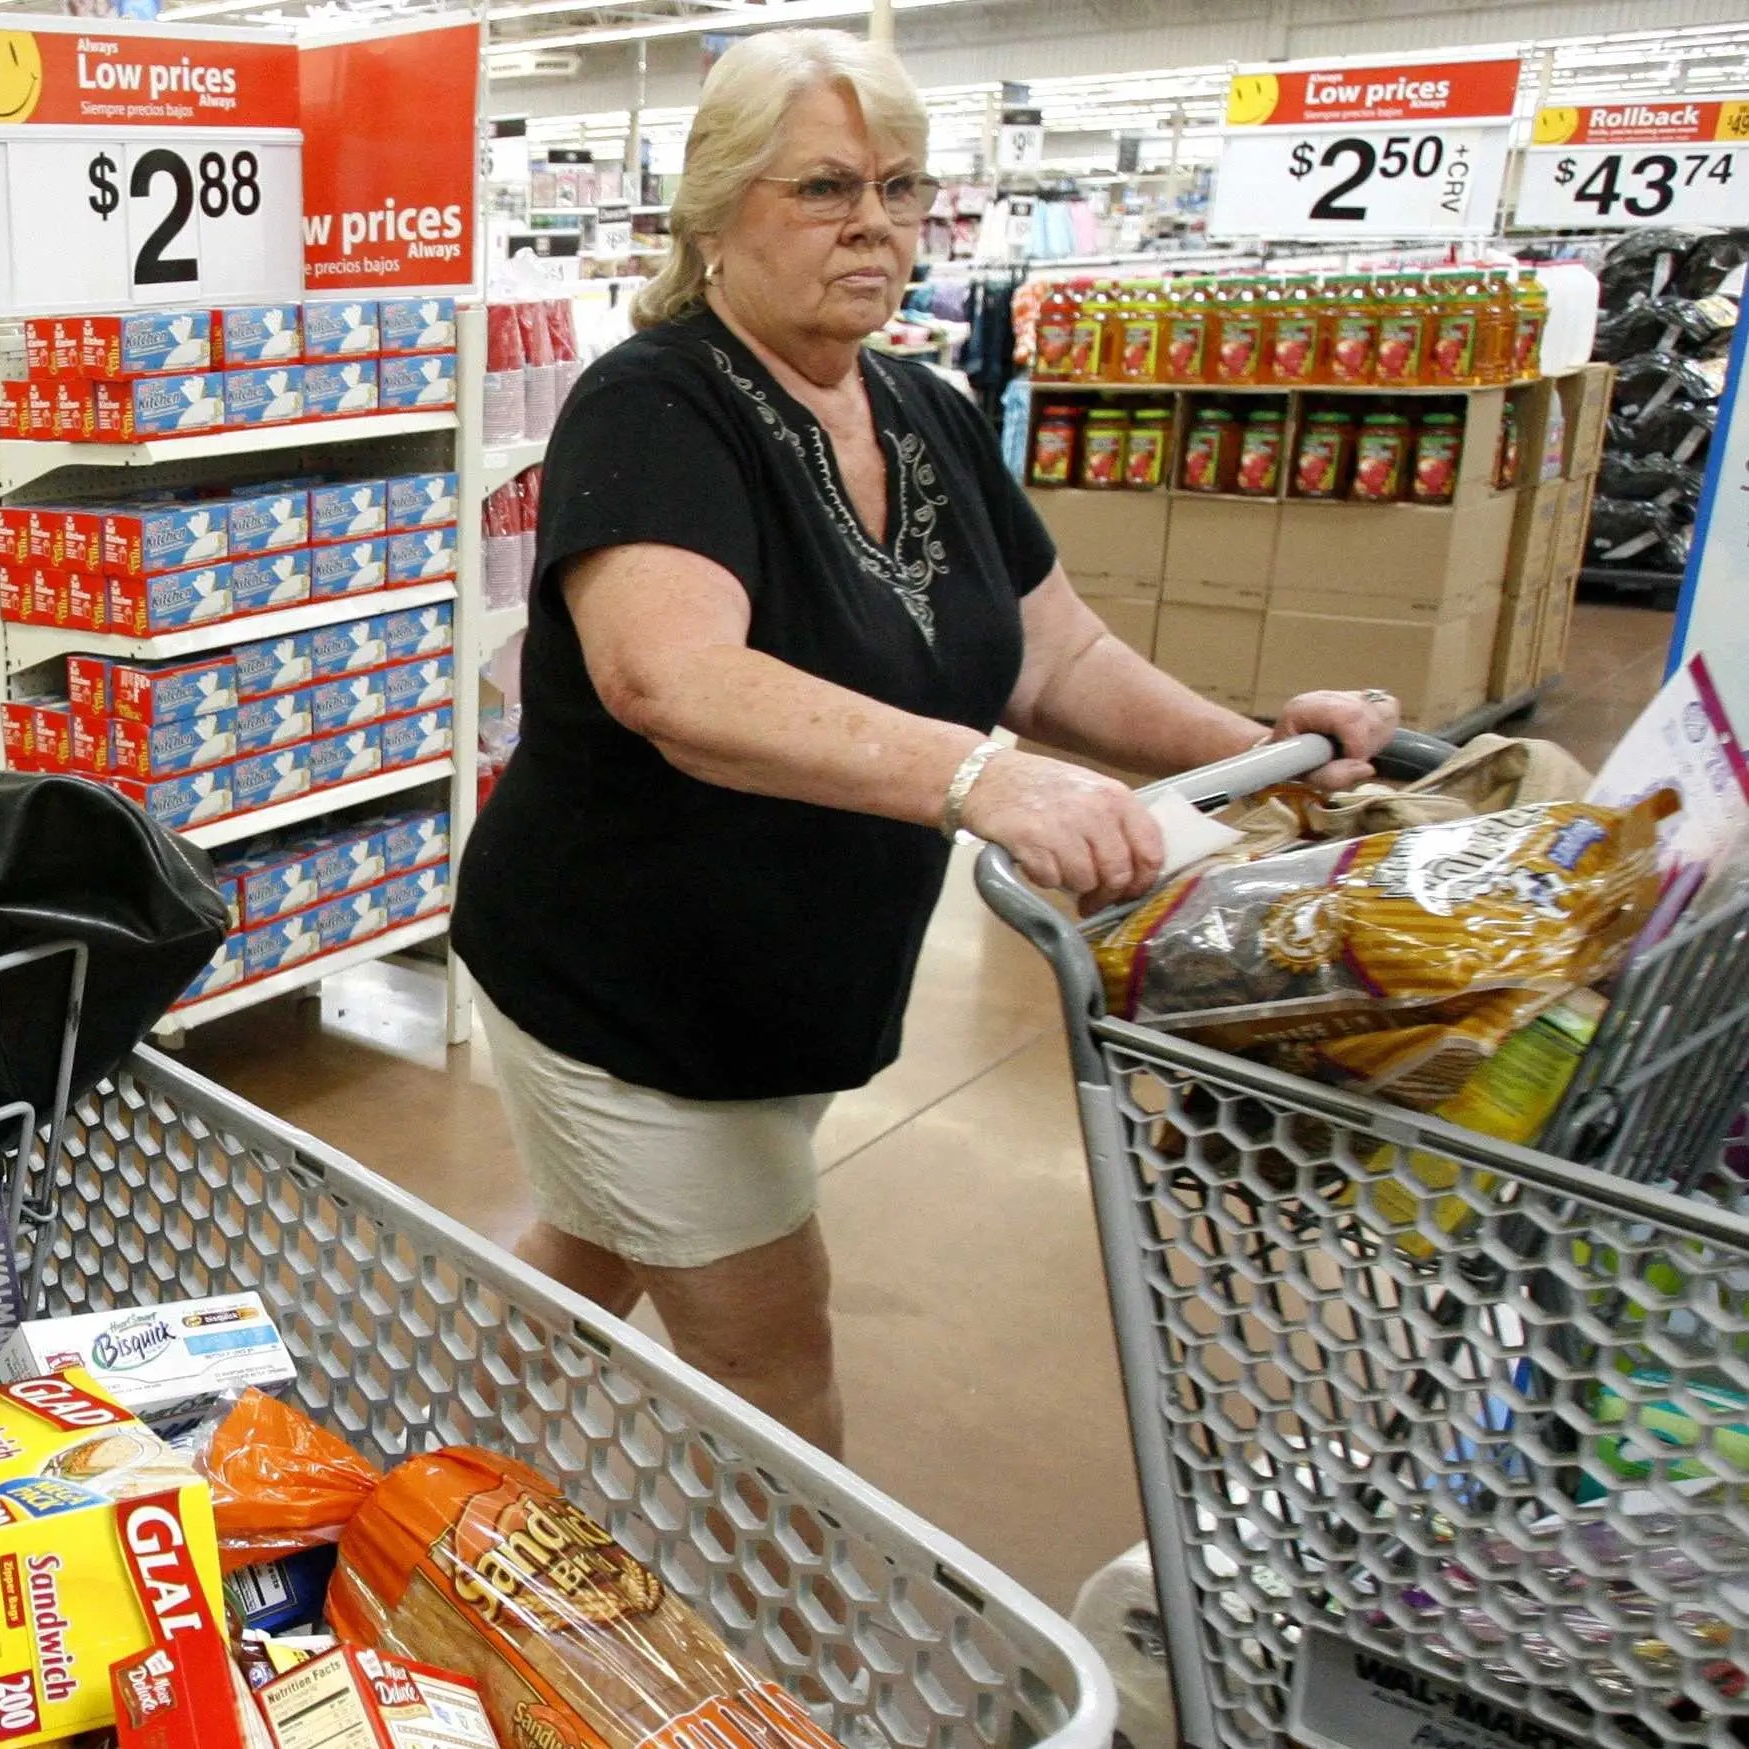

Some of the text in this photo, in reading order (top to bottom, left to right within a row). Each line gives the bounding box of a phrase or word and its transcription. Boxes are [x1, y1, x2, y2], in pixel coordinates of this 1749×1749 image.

[77, 37, 119, 55] Always
[78, 53, 236, 100] Low prices
[1304, 77, 1450, 107] Low prices
[80, 101, 194, 120] Siempre precios bajos
[198, 94, 236, 111] Always
[1589, 105, 1700, 128] Rollback
[342, 197, 463, 256] prices
[314, 259, 361, 279] precios
[363, 256, 400, 276] bajos
[407, 242, 461, 261] Always
[95, 1321, 178, 1369] Bisquick
[9, 1379, 116, 1426] GLAD
[2, 1561, 19, 1622] Zipper Bags
[27, 1555, 78, 1702] Sandwich
[128, 1665, 157, 1715] Deluxe
[267, 1660, 341, 1705] Nutrition Facts
[375, 1679, 420, 1706] Deluxe
